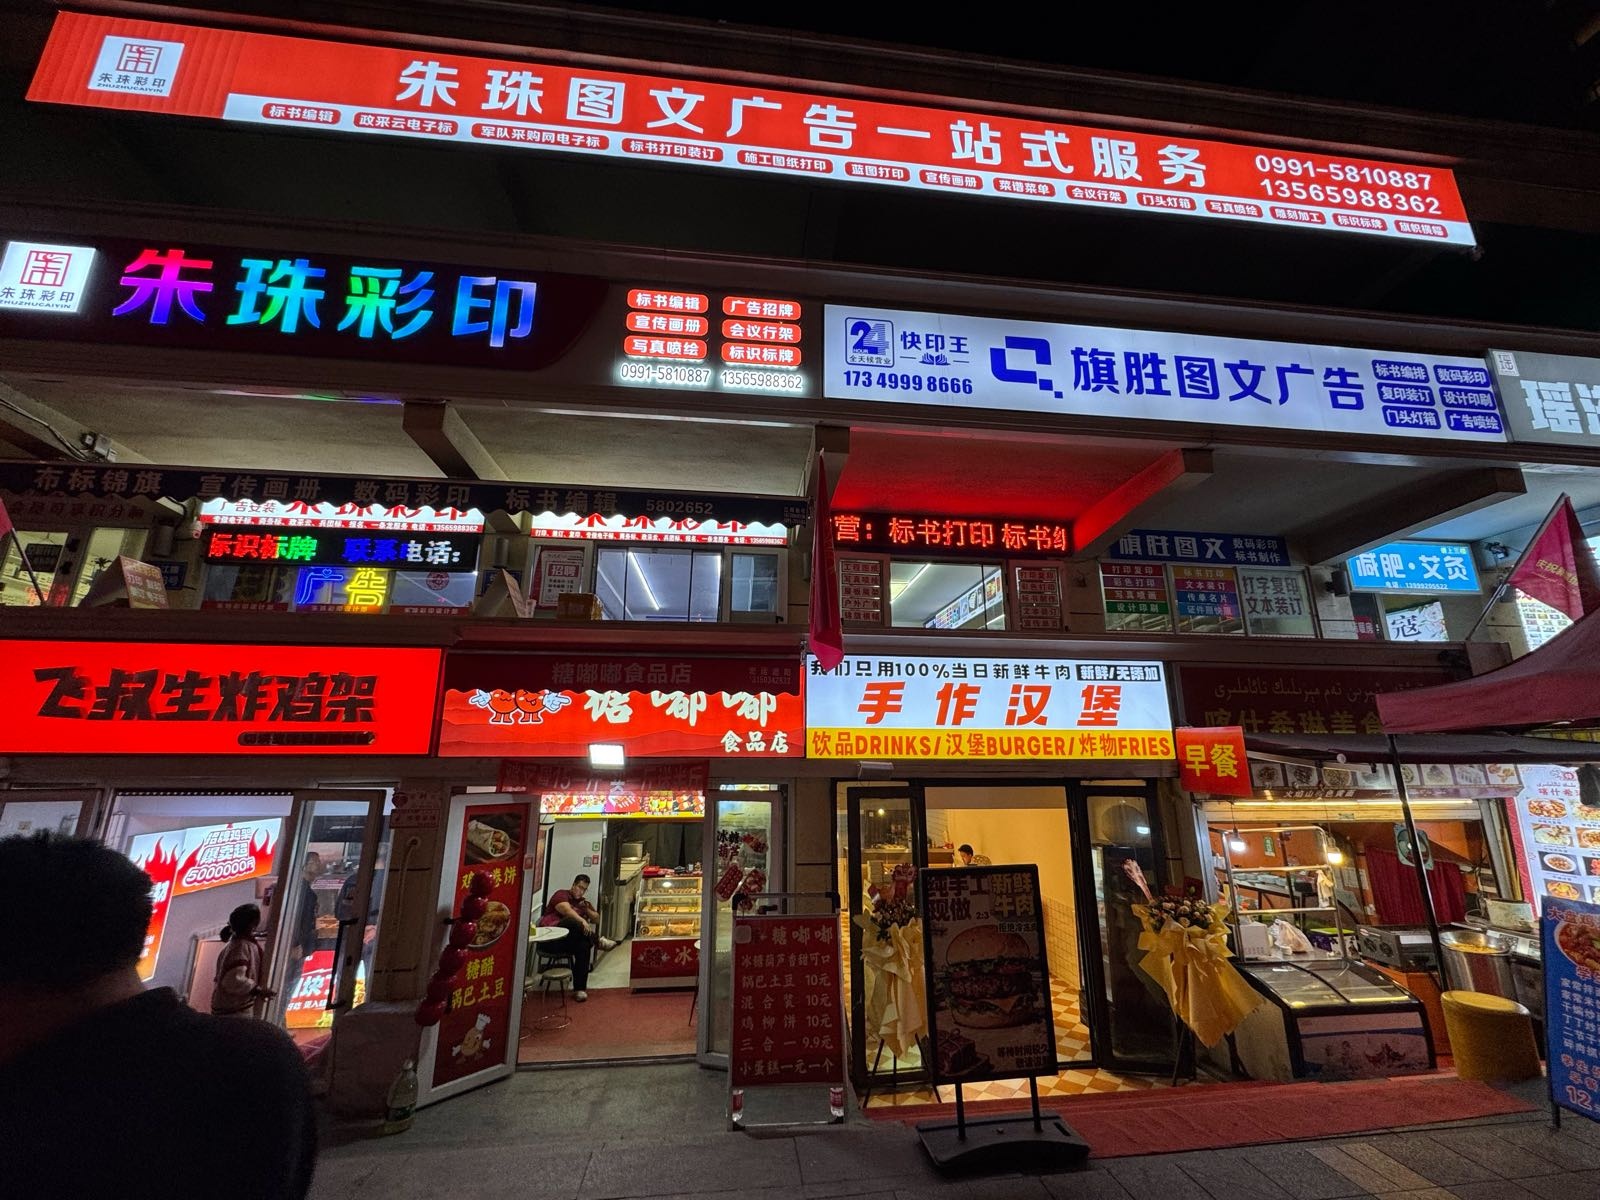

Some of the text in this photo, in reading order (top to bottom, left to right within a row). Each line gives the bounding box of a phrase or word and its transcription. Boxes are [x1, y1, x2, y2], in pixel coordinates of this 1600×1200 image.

[97, 83, 163, 93] ZHUZHUCAIYIN
[98, 72, 166, 88] 朱珠彩印
[396, 61, 1206, 187] 朱珠图文广告一站式服务
[269, 105, 334, 123] 标书编辑
[359, 115, 453, 134] 政采云电子标
[481, 125, 600, 148] 军队采购网电子标
[630, 140, 716, 161] 标书打印装订
[744, 152, 826, 171] 施工图纸打印
[851, 163, 904, 180] 蓝图打印
[925, 171, 977, 188] 宣传画册
[999, 179, 1050, 195] 菜谱菜单
[1072, 186, 1122, 202] 会议行架
[1142, 194, 1191, 210] 门头灯箱
[1209, 202, 1259, 216] 写真喷绘
[1275, 209, 1322, 224] 雕刻加工
[1337, 215, 1384, 230] 标识标牌
[1255, 155, 1432, 190] 0991-5810887
[1261, 179, 1442, 215] 13565988362
[0, 287, 75, 302] 朱珠彩印
[112, 249, 537, 348] 朱珠彩印
[636, 292, 794, 317] 标书编辑 广告招牌
[634, 315, 794, 340] 宣传画册 会议行架
[632, 338, 794, 363] 写真喷绘 标识标牌
[900, 331, 970, 354] 快印王
[621, 364, 802, 389] 0991-5810887 13565988362
[843, 370, 973, 395] 173 4999 8666
[1070, 346, 1365, 411] 旗胜图文广告
[1375, 363, 1487, 385] 标书编排 数码彩印
[1381, 386, 1493, 407] 复印装订 设计印刷
[1386, 408, 1500, 430] 门头灯箱 广告喷绘
[34, 468, 714, 515] 布标锦旗 宣传画册 数码彩印 标书编辑 5802652
[889, 517, 994, 547] 标书打印
[208, 532, 317, 561] 标识标牌
[1232, 537, 1278, 551] 数码彩印
[551, 564, 577, 577] 招聘
[1111, 564, 1153, 575] 打印复印
[296, 566, 388, 606] 广告
[1113, 577, 1155, 587] 彩色打印
[1185, 580, 1226, 591] 文本装订
[1242, 575, 1299, 595] 打字复印
[1247, 596, 1301, 616] 文本装订
[1391, 615, 1421, 639] 寇
[552, 662, 693, 685] 糖嘟嘟食品店
[1079, 663, 1160, 682] 新鲜/无添加
[33, 665, 379, 723] 飞叔生炸鸡架
[857, 681, 1122, 727] 手作汉堡
[721, 730, 790, 754] 食品店
[1185, 743, 1239, 778] 早餐
[994, 895, 1035, 918] 牛肉
[772, 925, 833, 945] 糖嘟嘟
[741, 952, 831, 967] 冰糖葫芦香甜可口
[741, 973, 832, 988] 锅巴土豆 10元
[741, 993, 832, 1009] 混合装 10元
[806, 1014, 833, 1028] 10元
[740, 1034, 834, 1052] 三合一 9.9元
[740, 1058, 834, 1076] 小蛋糕一元一个
